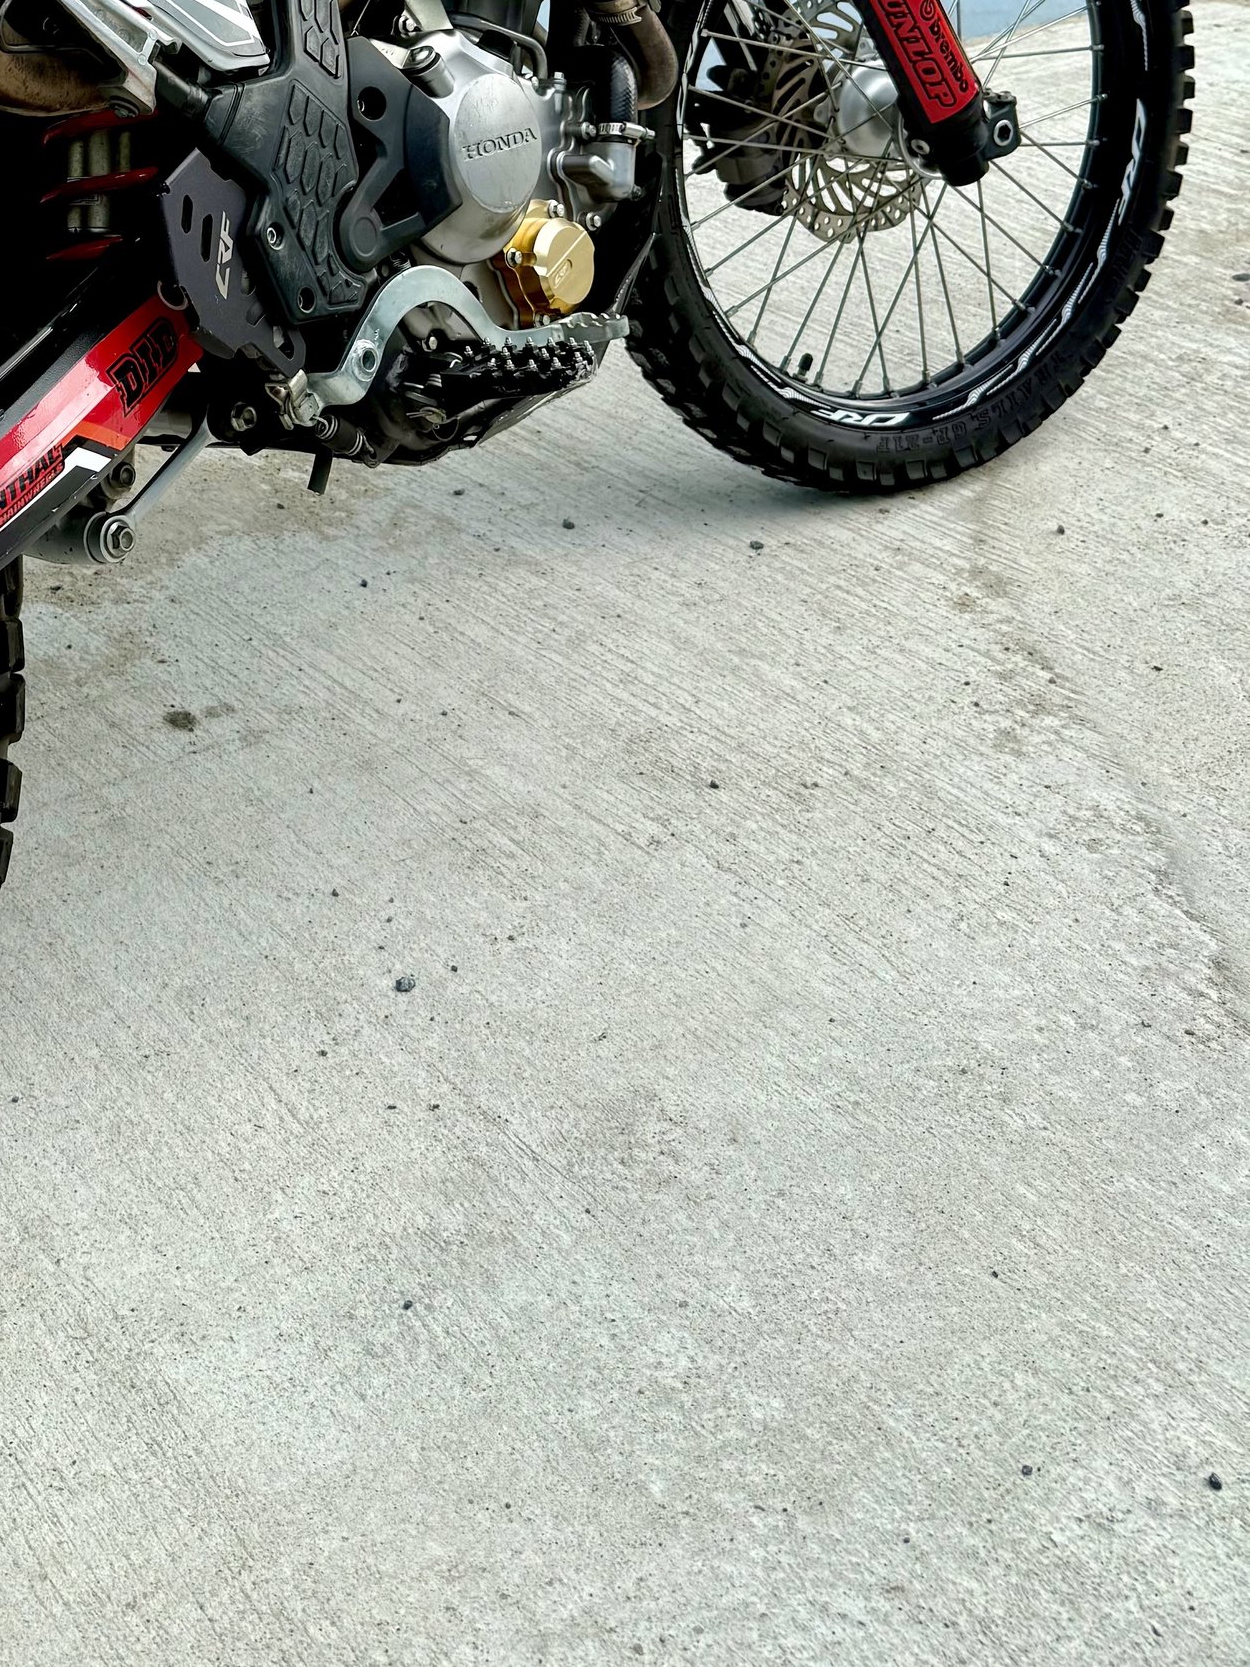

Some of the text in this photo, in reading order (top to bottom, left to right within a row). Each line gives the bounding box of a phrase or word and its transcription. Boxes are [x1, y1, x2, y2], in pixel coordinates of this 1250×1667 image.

[928, 16, 969, 94] brembo
[462, 127, 538, 162] HONDA
[214, 211, 231, 300] CRF
[108, 319, 180, 415] DID
